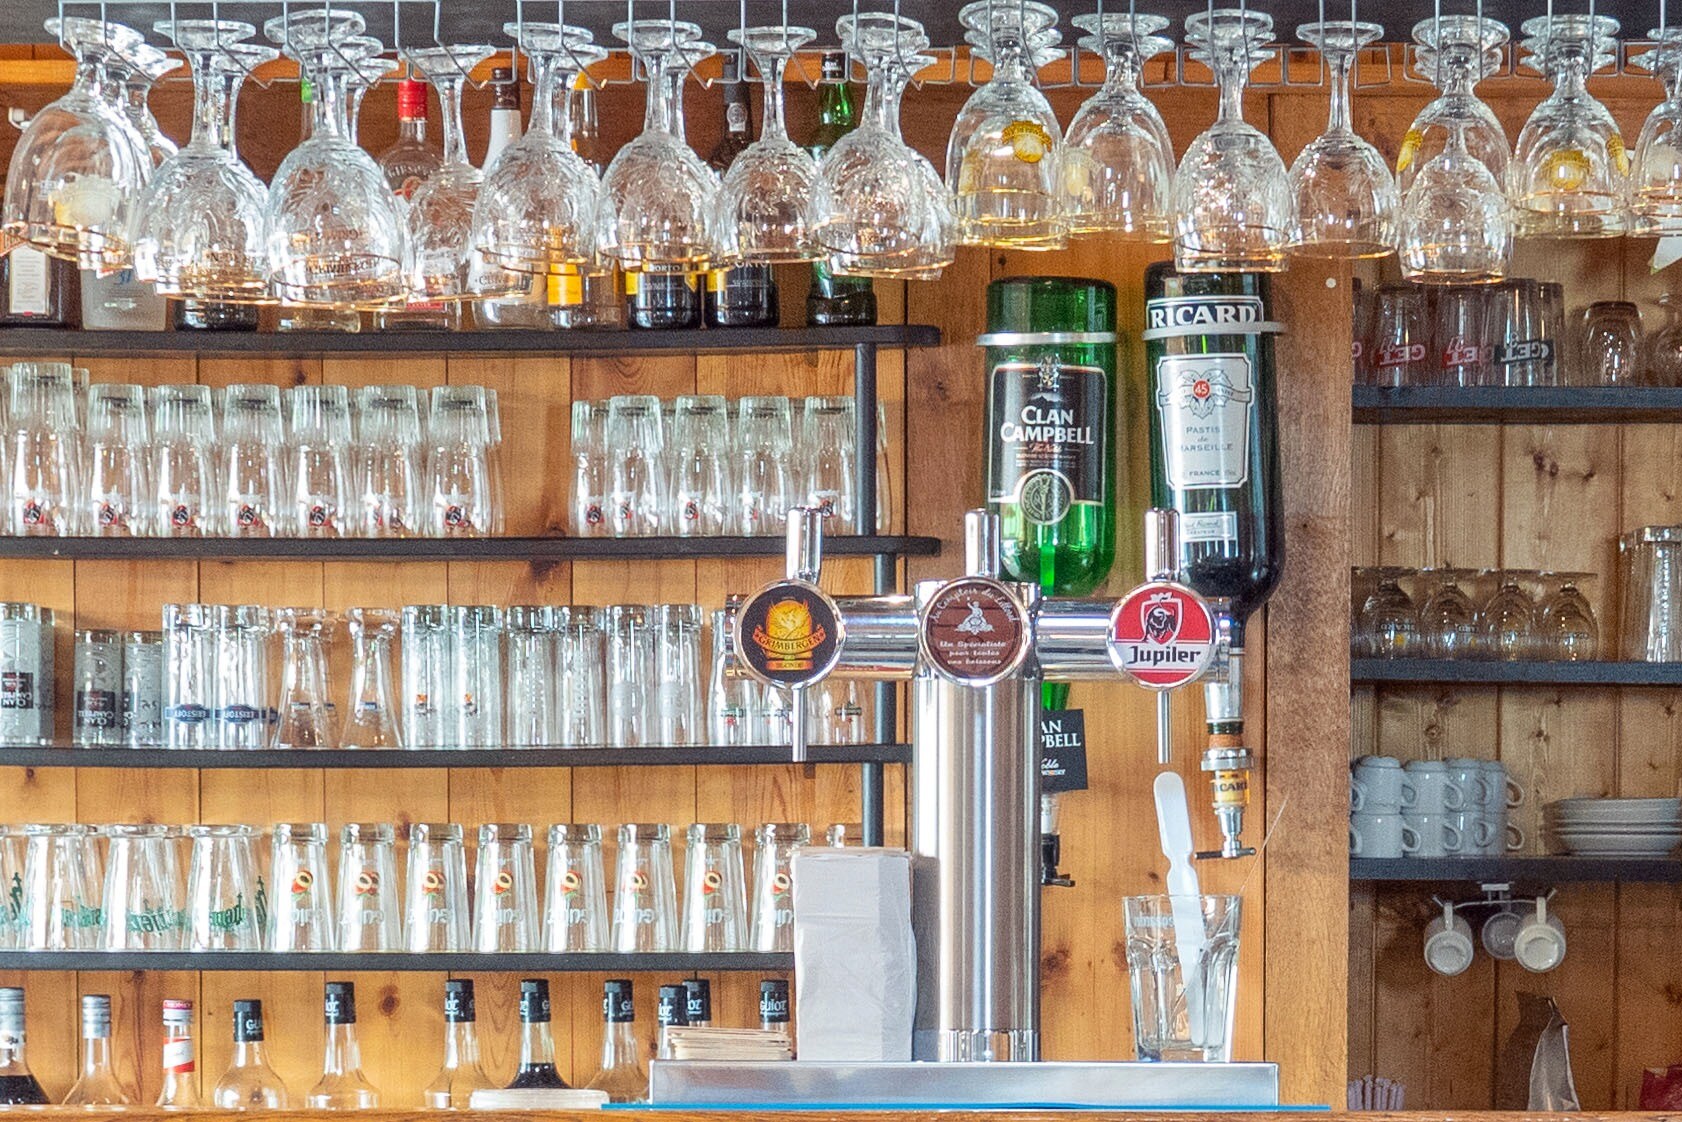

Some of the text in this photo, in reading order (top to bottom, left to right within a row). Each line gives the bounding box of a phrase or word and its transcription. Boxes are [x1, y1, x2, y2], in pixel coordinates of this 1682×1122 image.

[1150, 305, 1256, 328] RICARD
[1195, 383, 1208, 396] 45
[1021, 405, 1074, 426] CLAN
[1000, 422, 1094, 445] CAMPBELL
[1186, 426, 1221, 434] PASTIS
[759, 633, 823, 651] GRIMBERGEN
[1126, 646, 1201, 667] Jupiler
[1041, 719, 1062, 734] AN
